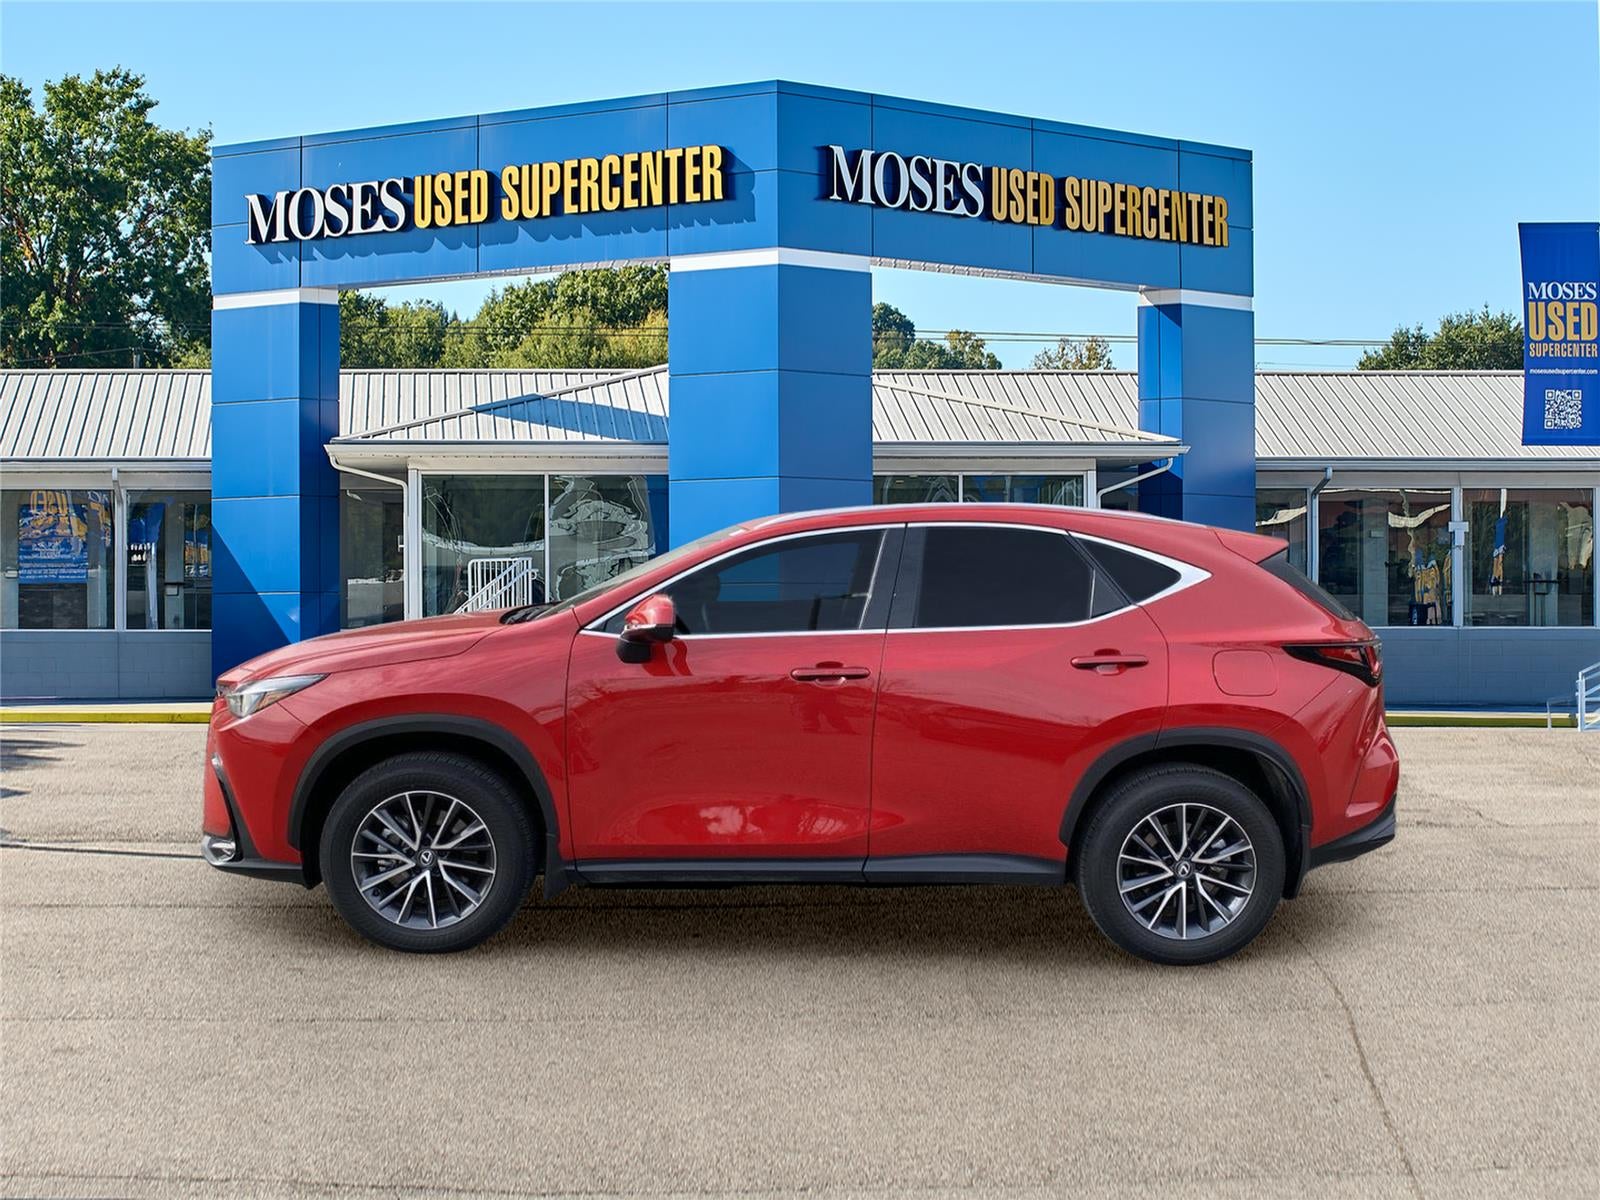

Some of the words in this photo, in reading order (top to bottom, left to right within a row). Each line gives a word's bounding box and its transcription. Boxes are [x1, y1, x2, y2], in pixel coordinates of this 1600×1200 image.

[244, 177, 406, 245] MOSES
[413, 169, 489, 229] USED
[501, 144, 724, 221] SUPERCENTER
[829, 145, 985, 218] MOSES
[990, 166, 1055, 226] USED
[1064, 176, 1230, 247] SUPERCENTER
[1528, 281, 1597, 301] MOSES
[1528, 301, 1598, 341] USED
[1529, 342, 1598, 358] SUPERCENTER
